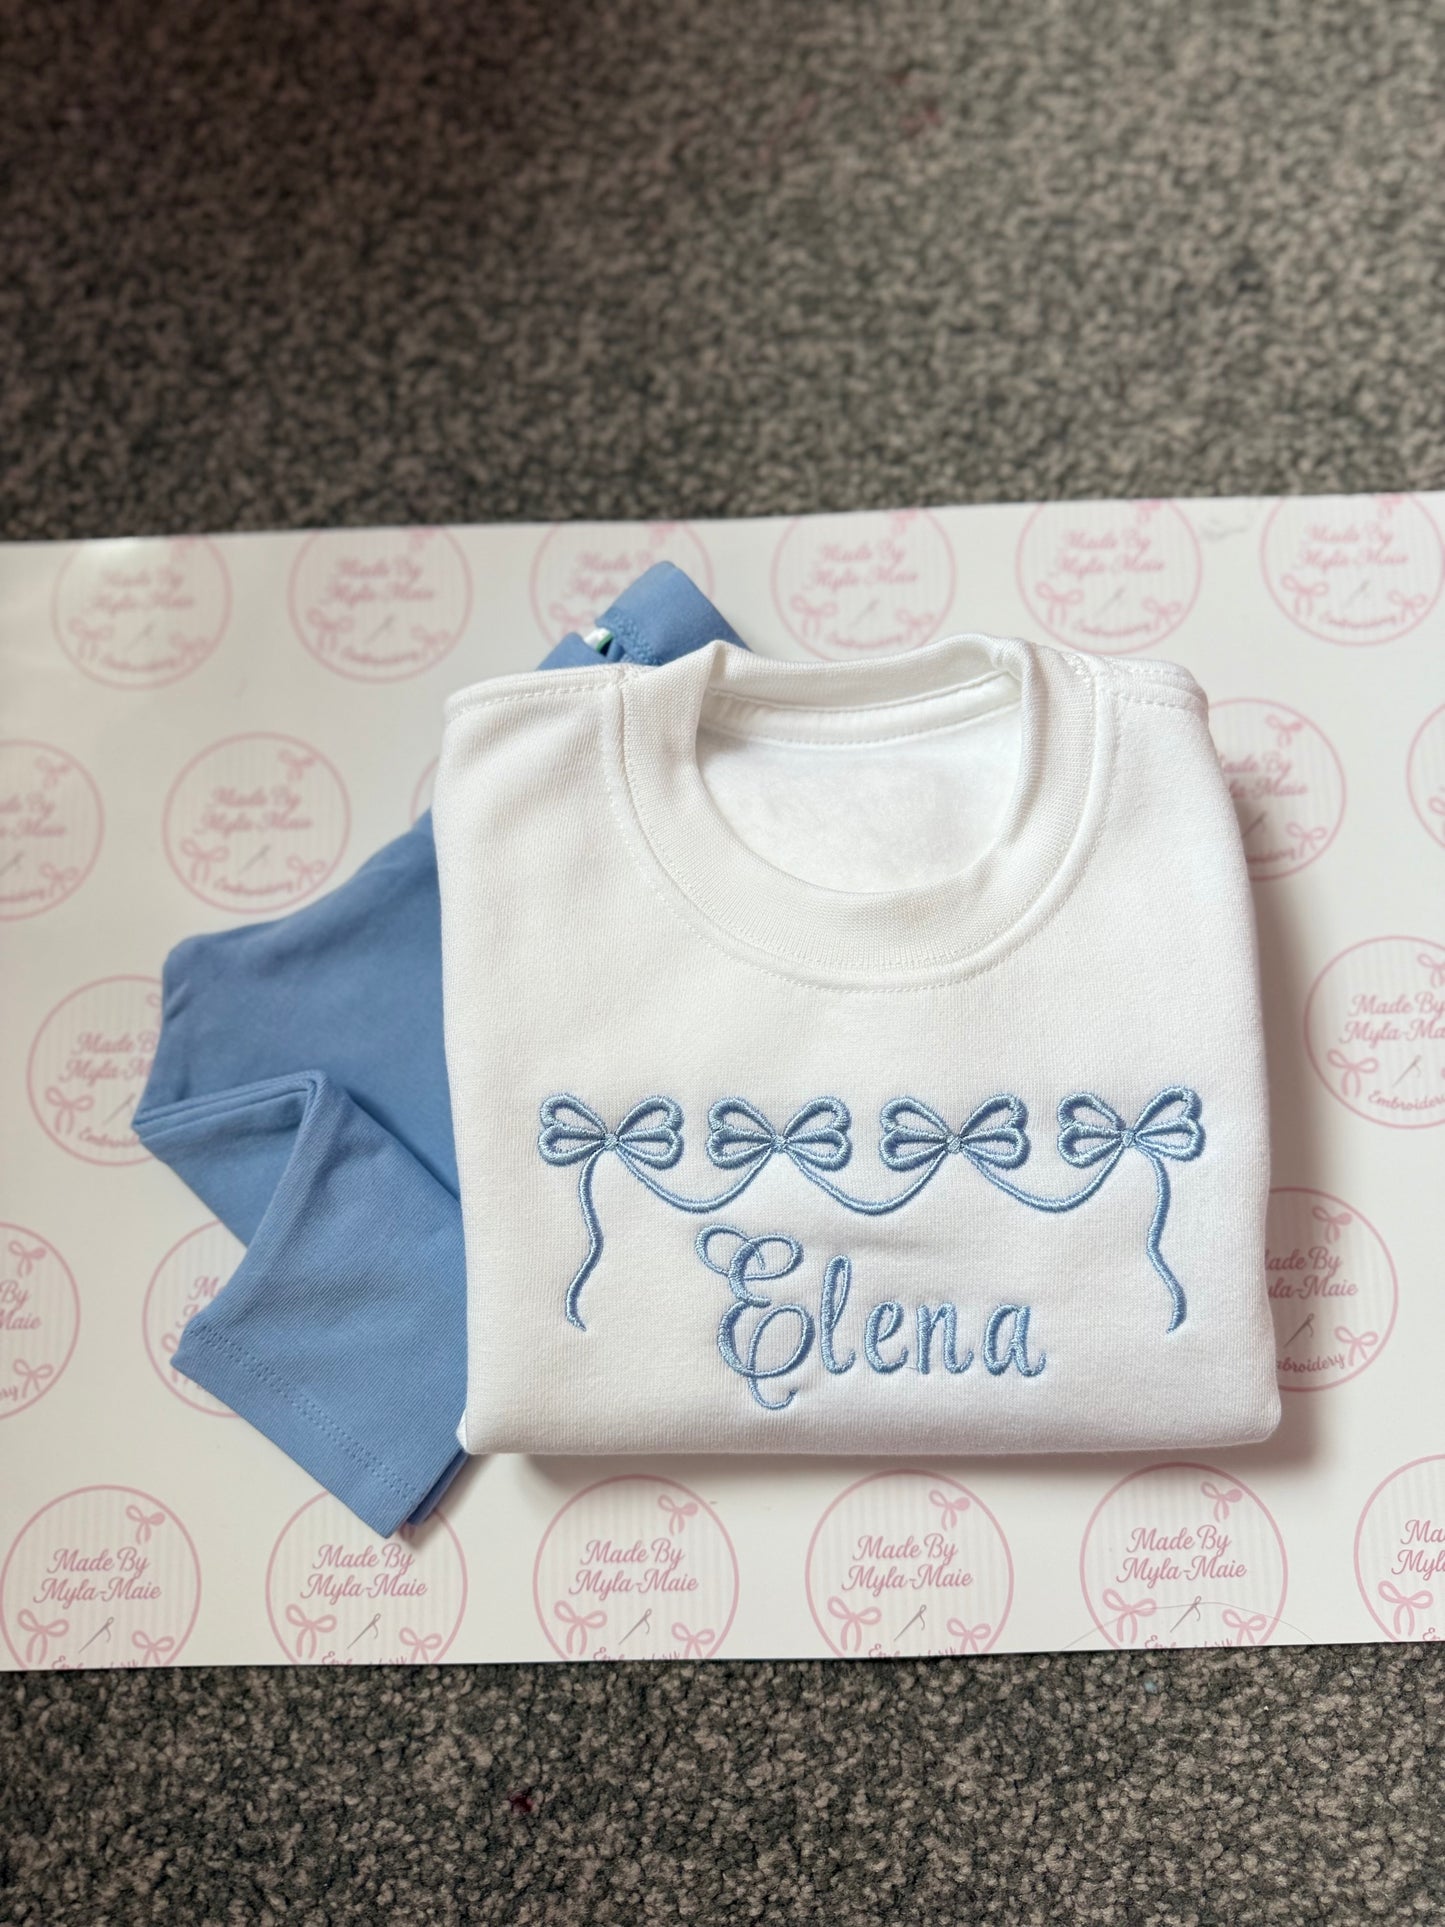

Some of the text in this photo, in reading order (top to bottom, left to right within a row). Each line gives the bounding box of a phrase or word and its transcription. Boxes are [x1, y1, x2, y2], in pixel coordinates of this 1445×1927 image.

[1308, 1246, 1342, 1278] By
[695, 1223, 1047, 1410] Elena
[580, 1537, 685, 1571] Made By
[852, 1533, 958, 1566] Made By
[1126, 1524, 1232, 1558] Made By
[46, 1546, 150, 1580] Made By
[312, 1542, 415, 1576] Made By
